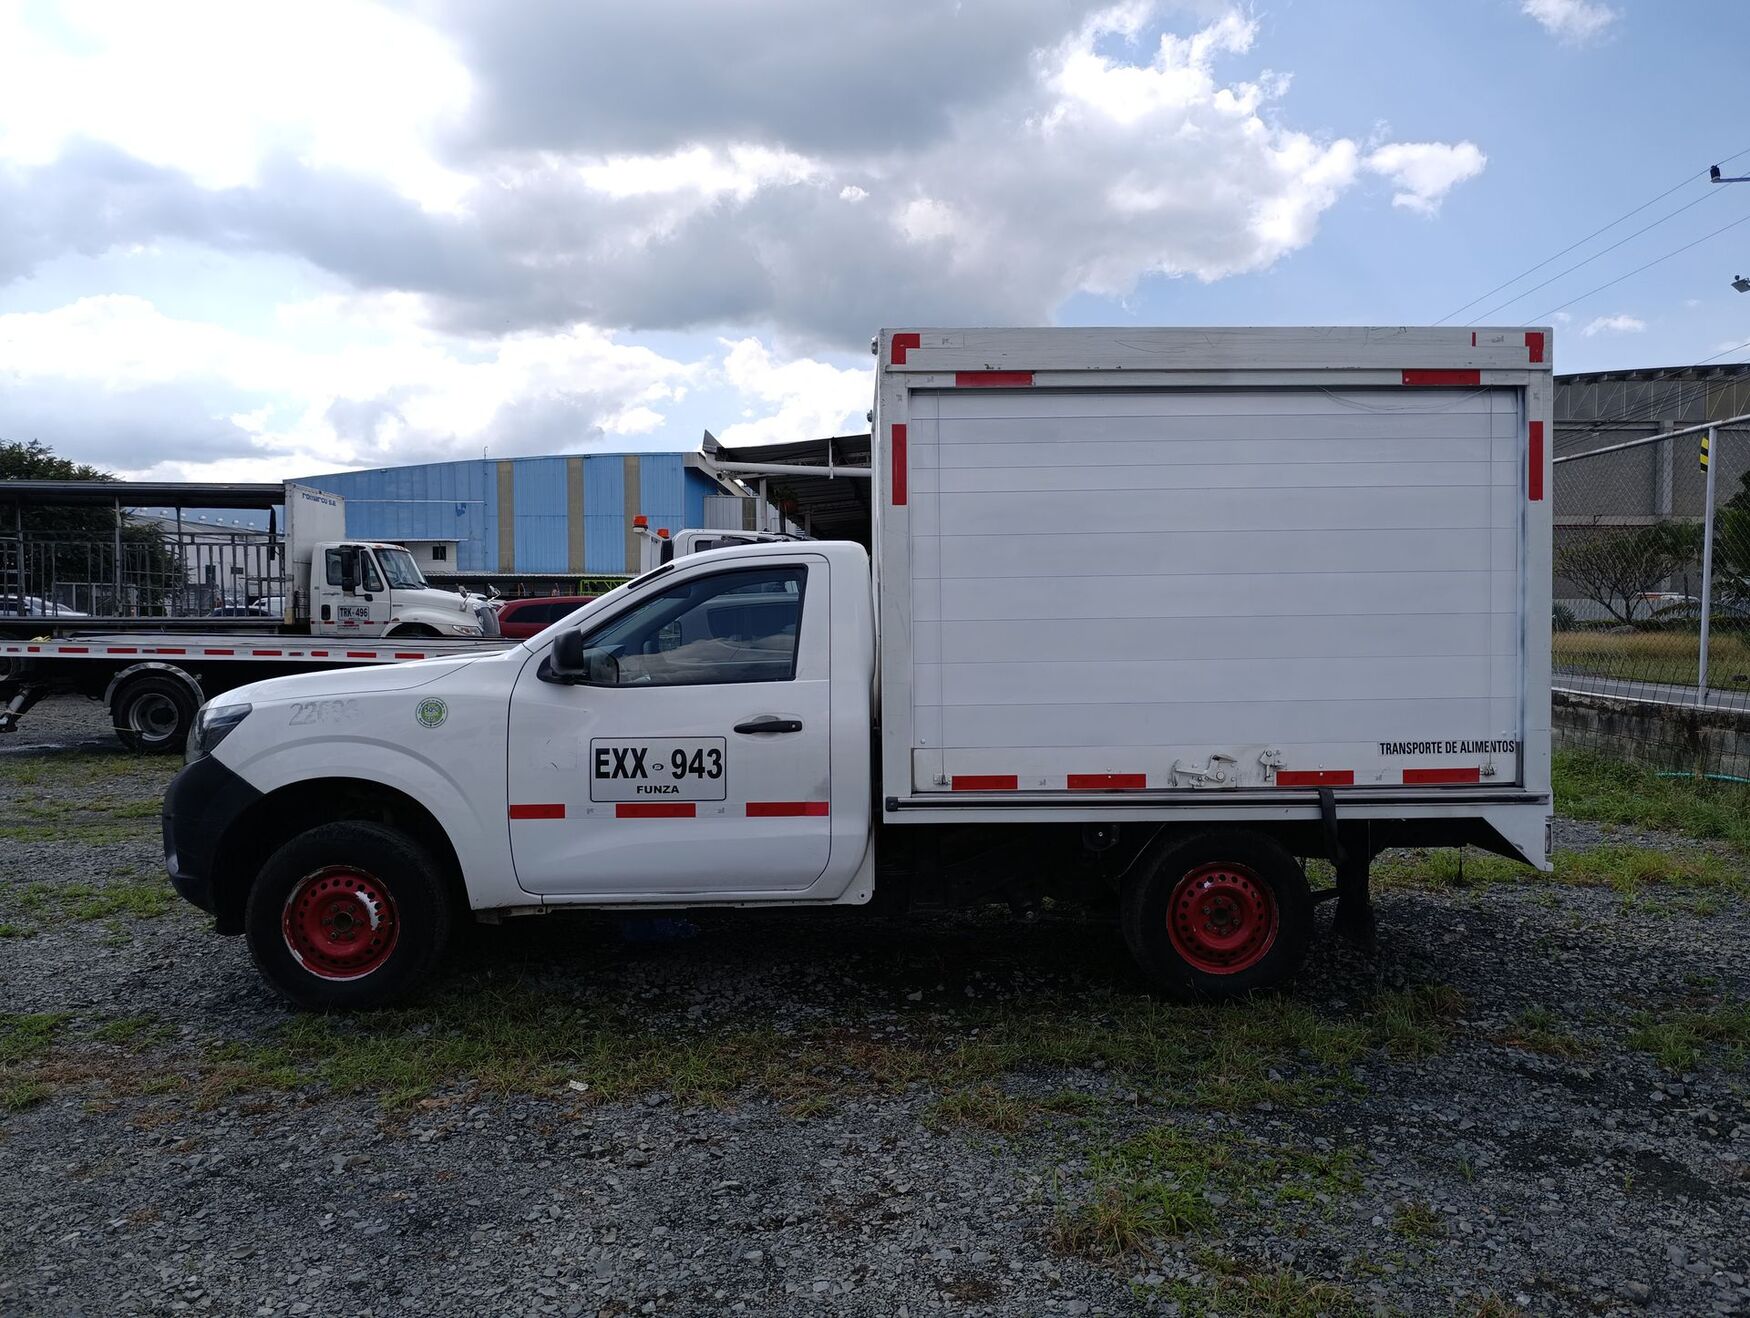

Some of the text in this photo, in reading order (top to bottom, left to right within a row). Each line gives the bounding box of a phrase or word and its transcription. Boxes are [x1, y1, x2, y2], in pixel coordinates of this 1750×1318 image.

[1380, 740, 1516, 755] TRANSPORTE DE ALIMENTOS
[595, 747, 723, 780] EXX 943
[636, 785, 680, 794] FUNZA
